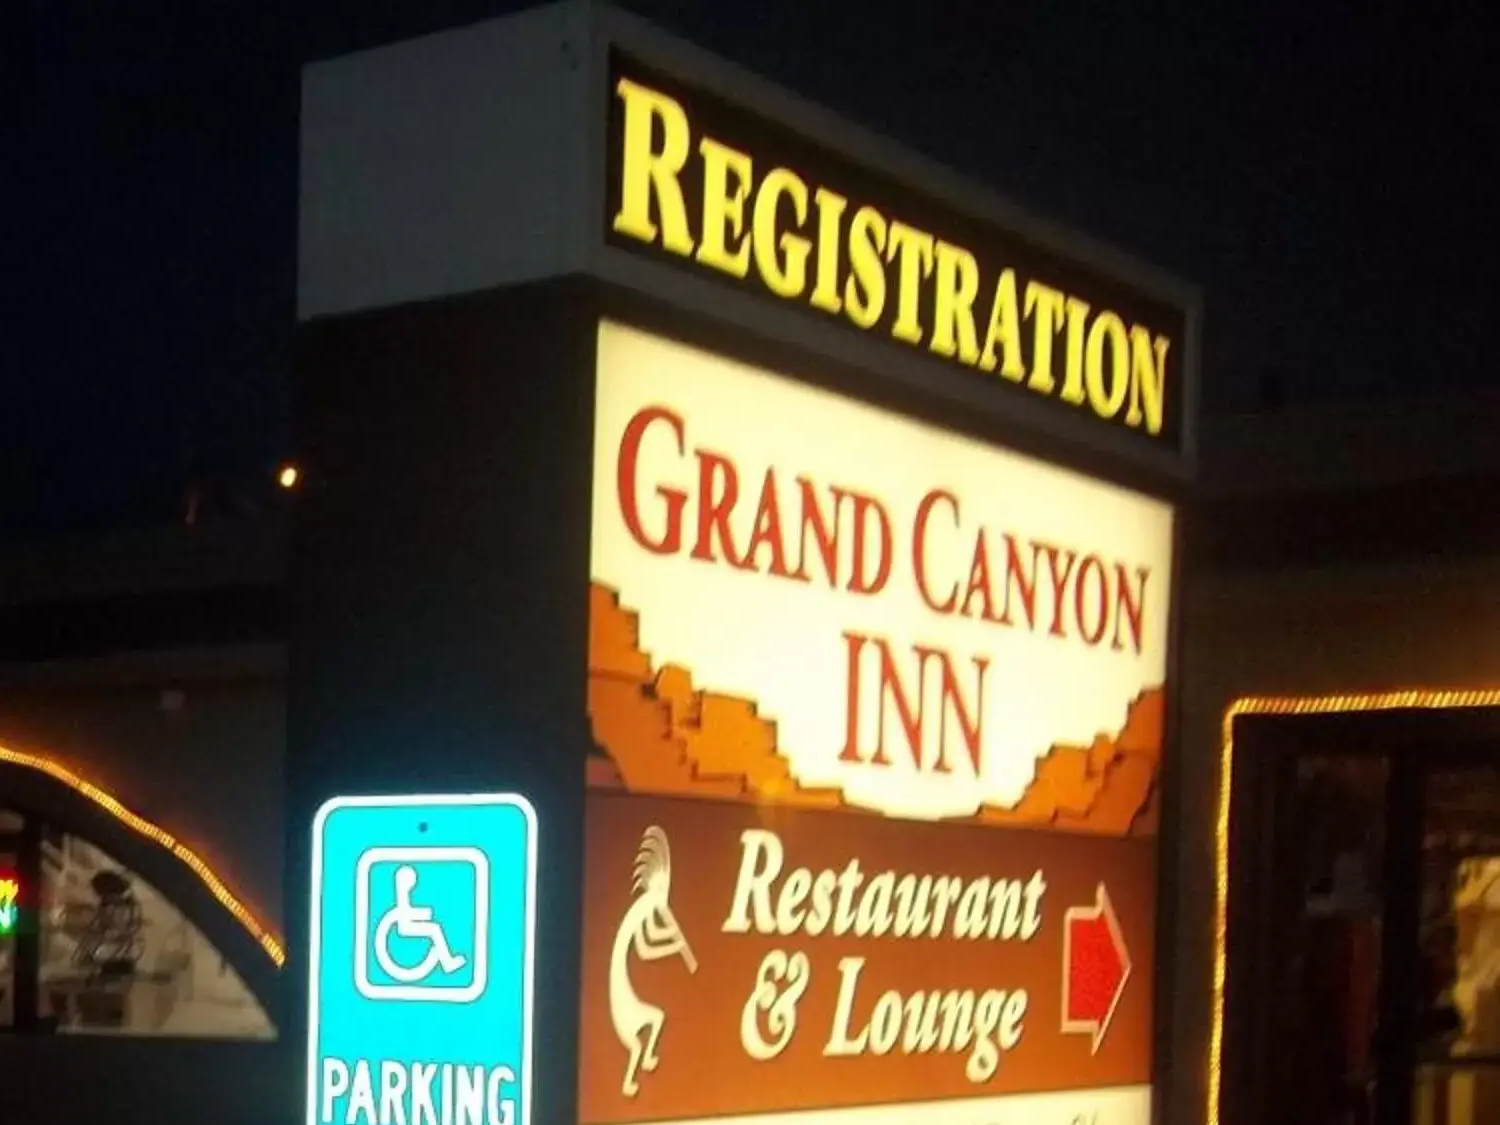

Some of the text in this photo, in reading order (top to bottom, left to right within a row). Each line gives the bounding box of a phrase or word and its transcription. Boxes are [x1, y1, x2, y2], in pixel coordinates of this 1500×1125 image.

[613, 79, 1169, 436] REGISTRATION
[616, 407, 1149, 656] GRAND CANYON
[837, 631, 990, 777] INN
[722, 829, 1046, 939] Restaurant
[740, 949, 1028, 1083] & Lounge
